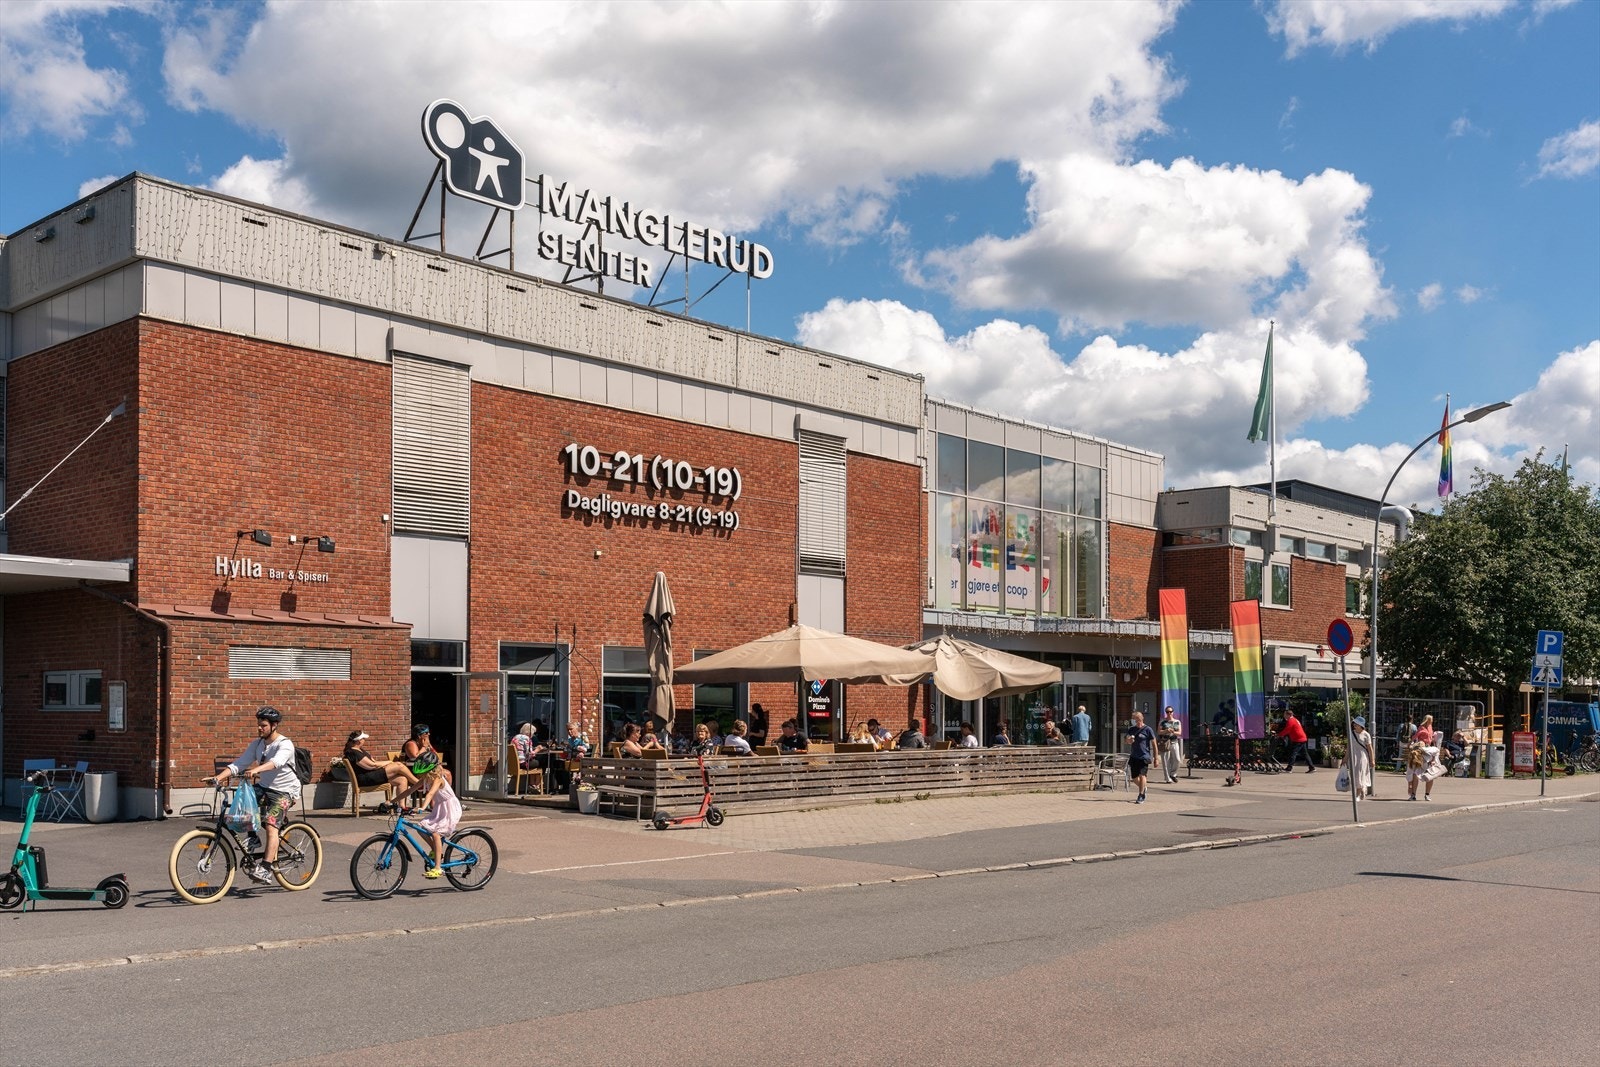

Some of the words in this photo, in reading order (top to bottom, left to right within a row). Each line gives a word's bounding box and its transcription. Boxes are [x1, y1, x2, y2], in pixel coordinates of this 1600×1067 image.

[538, 173, 774, 279] MANGLERUD
[538, 229, 652, 287] SENTER
[565, 443, 643, 483] 10-21
[651, 455, 742, 501] (10-19)
[568, 489, 656, 519] Dagligvare
[659, 502, 693, 523] 8-21
[696, 506, 740, 531] (9-19)
[215, 556, 262, 578] Hylla
[269, 568, 285, 579] Bar
[288, 569, 295, 580] &
[298, 570, 329, 582] Spiseri
[968, 578, 990, 594] gjøre
[1007, 585, 1028, 599] coop
[1543, 634, 1558, 652] P
[1109, 656, 1152, 670] Velkommen
[1541, 716, 1581, 725] OMWIL
